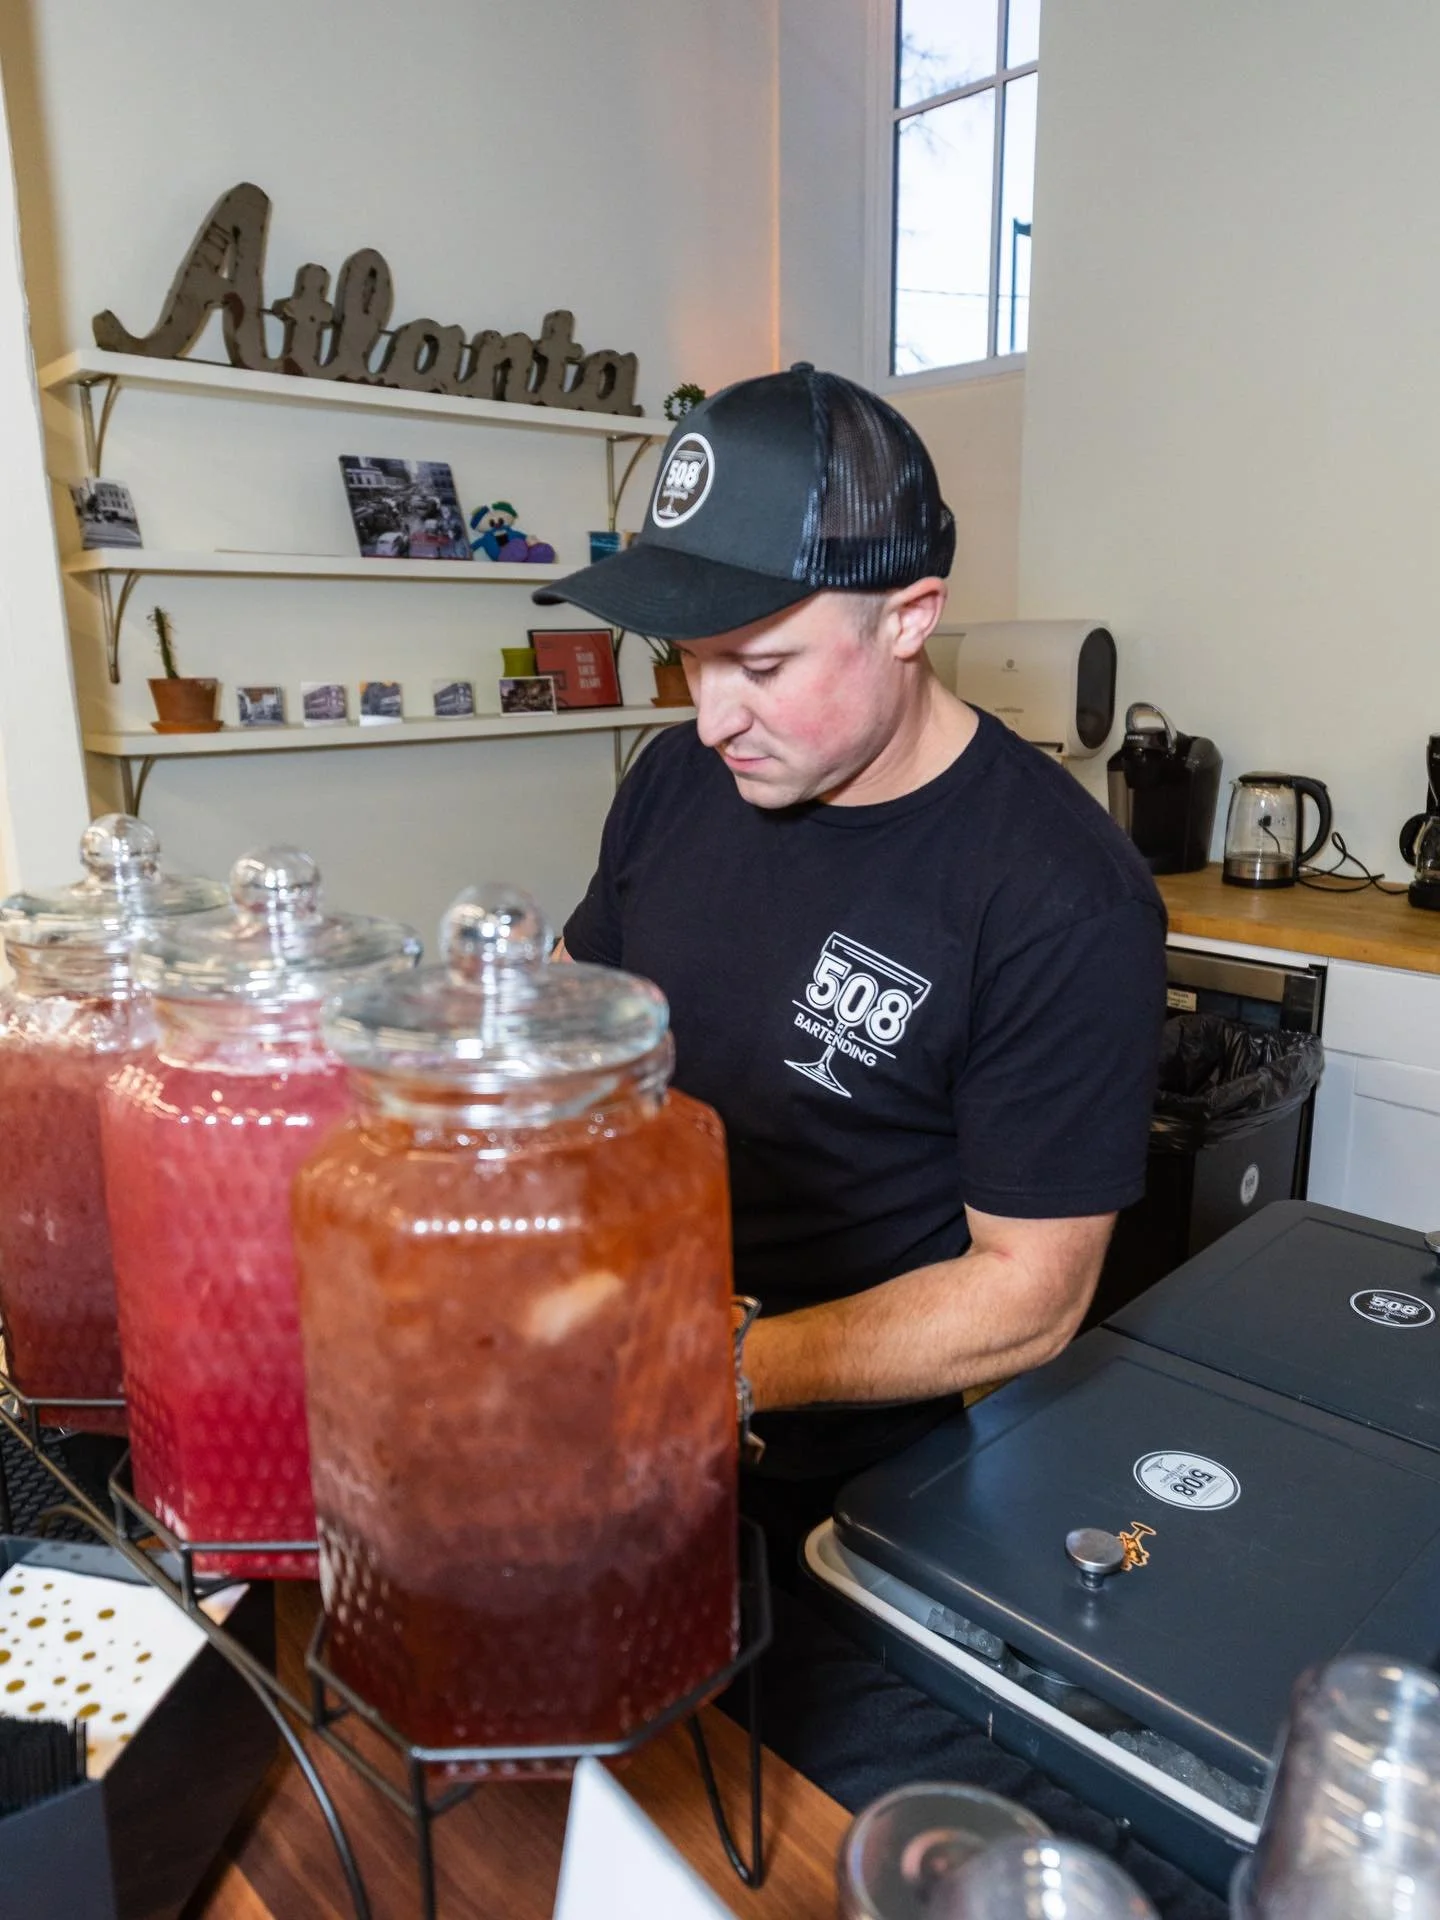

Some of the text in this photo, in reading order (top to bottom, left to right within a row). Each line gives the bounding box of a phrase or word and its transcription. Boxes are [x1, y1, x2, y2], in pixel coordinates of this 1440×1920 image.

[91, 181, 644, 418] Atlanta
[665, 459, 701, 490] 508
[805, 951, 914, 1046] 508
[793, 1012, 878, 1067] BARTENDING
[1369, 1296, 1419, 1316] 508
[1170, 1469, 1216, 1497] 508
